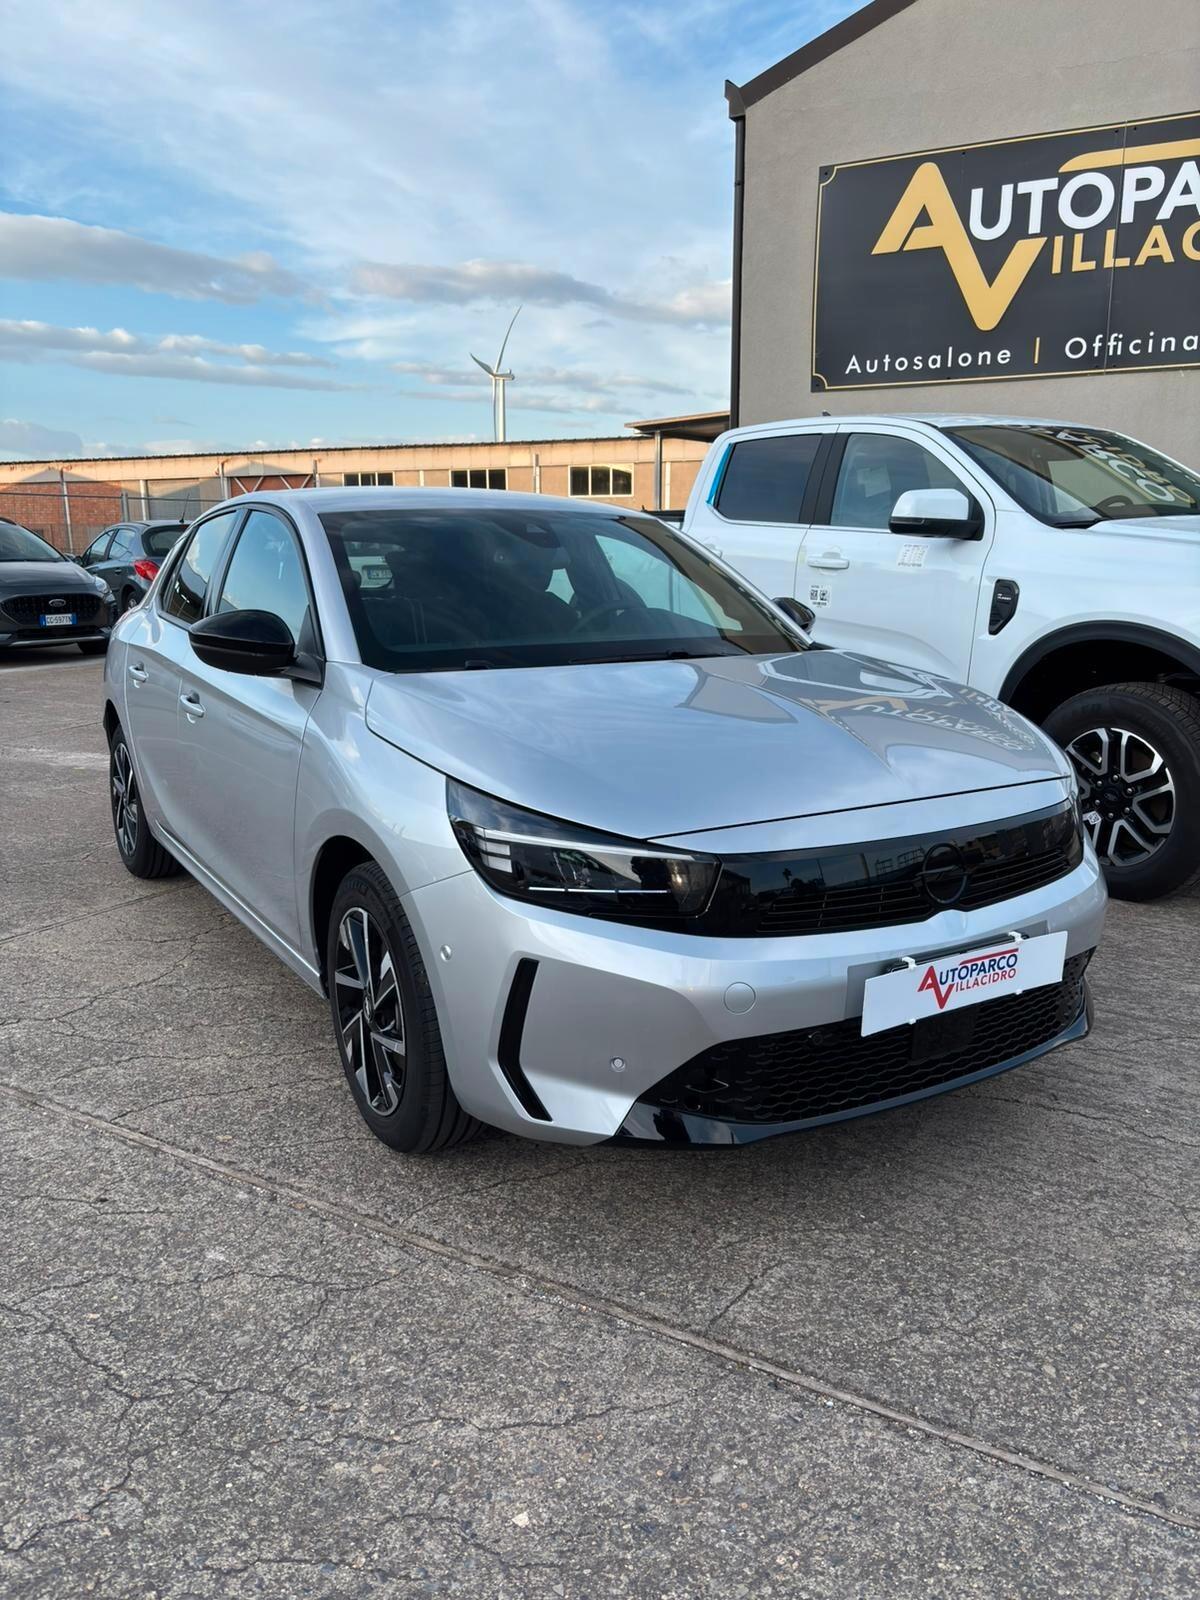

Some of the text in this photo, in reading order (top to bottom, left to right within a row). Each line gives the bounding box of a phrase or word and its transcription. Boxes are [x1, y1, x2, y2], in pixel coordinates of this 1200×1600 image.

[845, 331, 1199, 375] Autosalone Officina
[917, 953, 1018, 992] AUTOPARCO
[933, 967, 1017, 1009] VILLACIDRO
